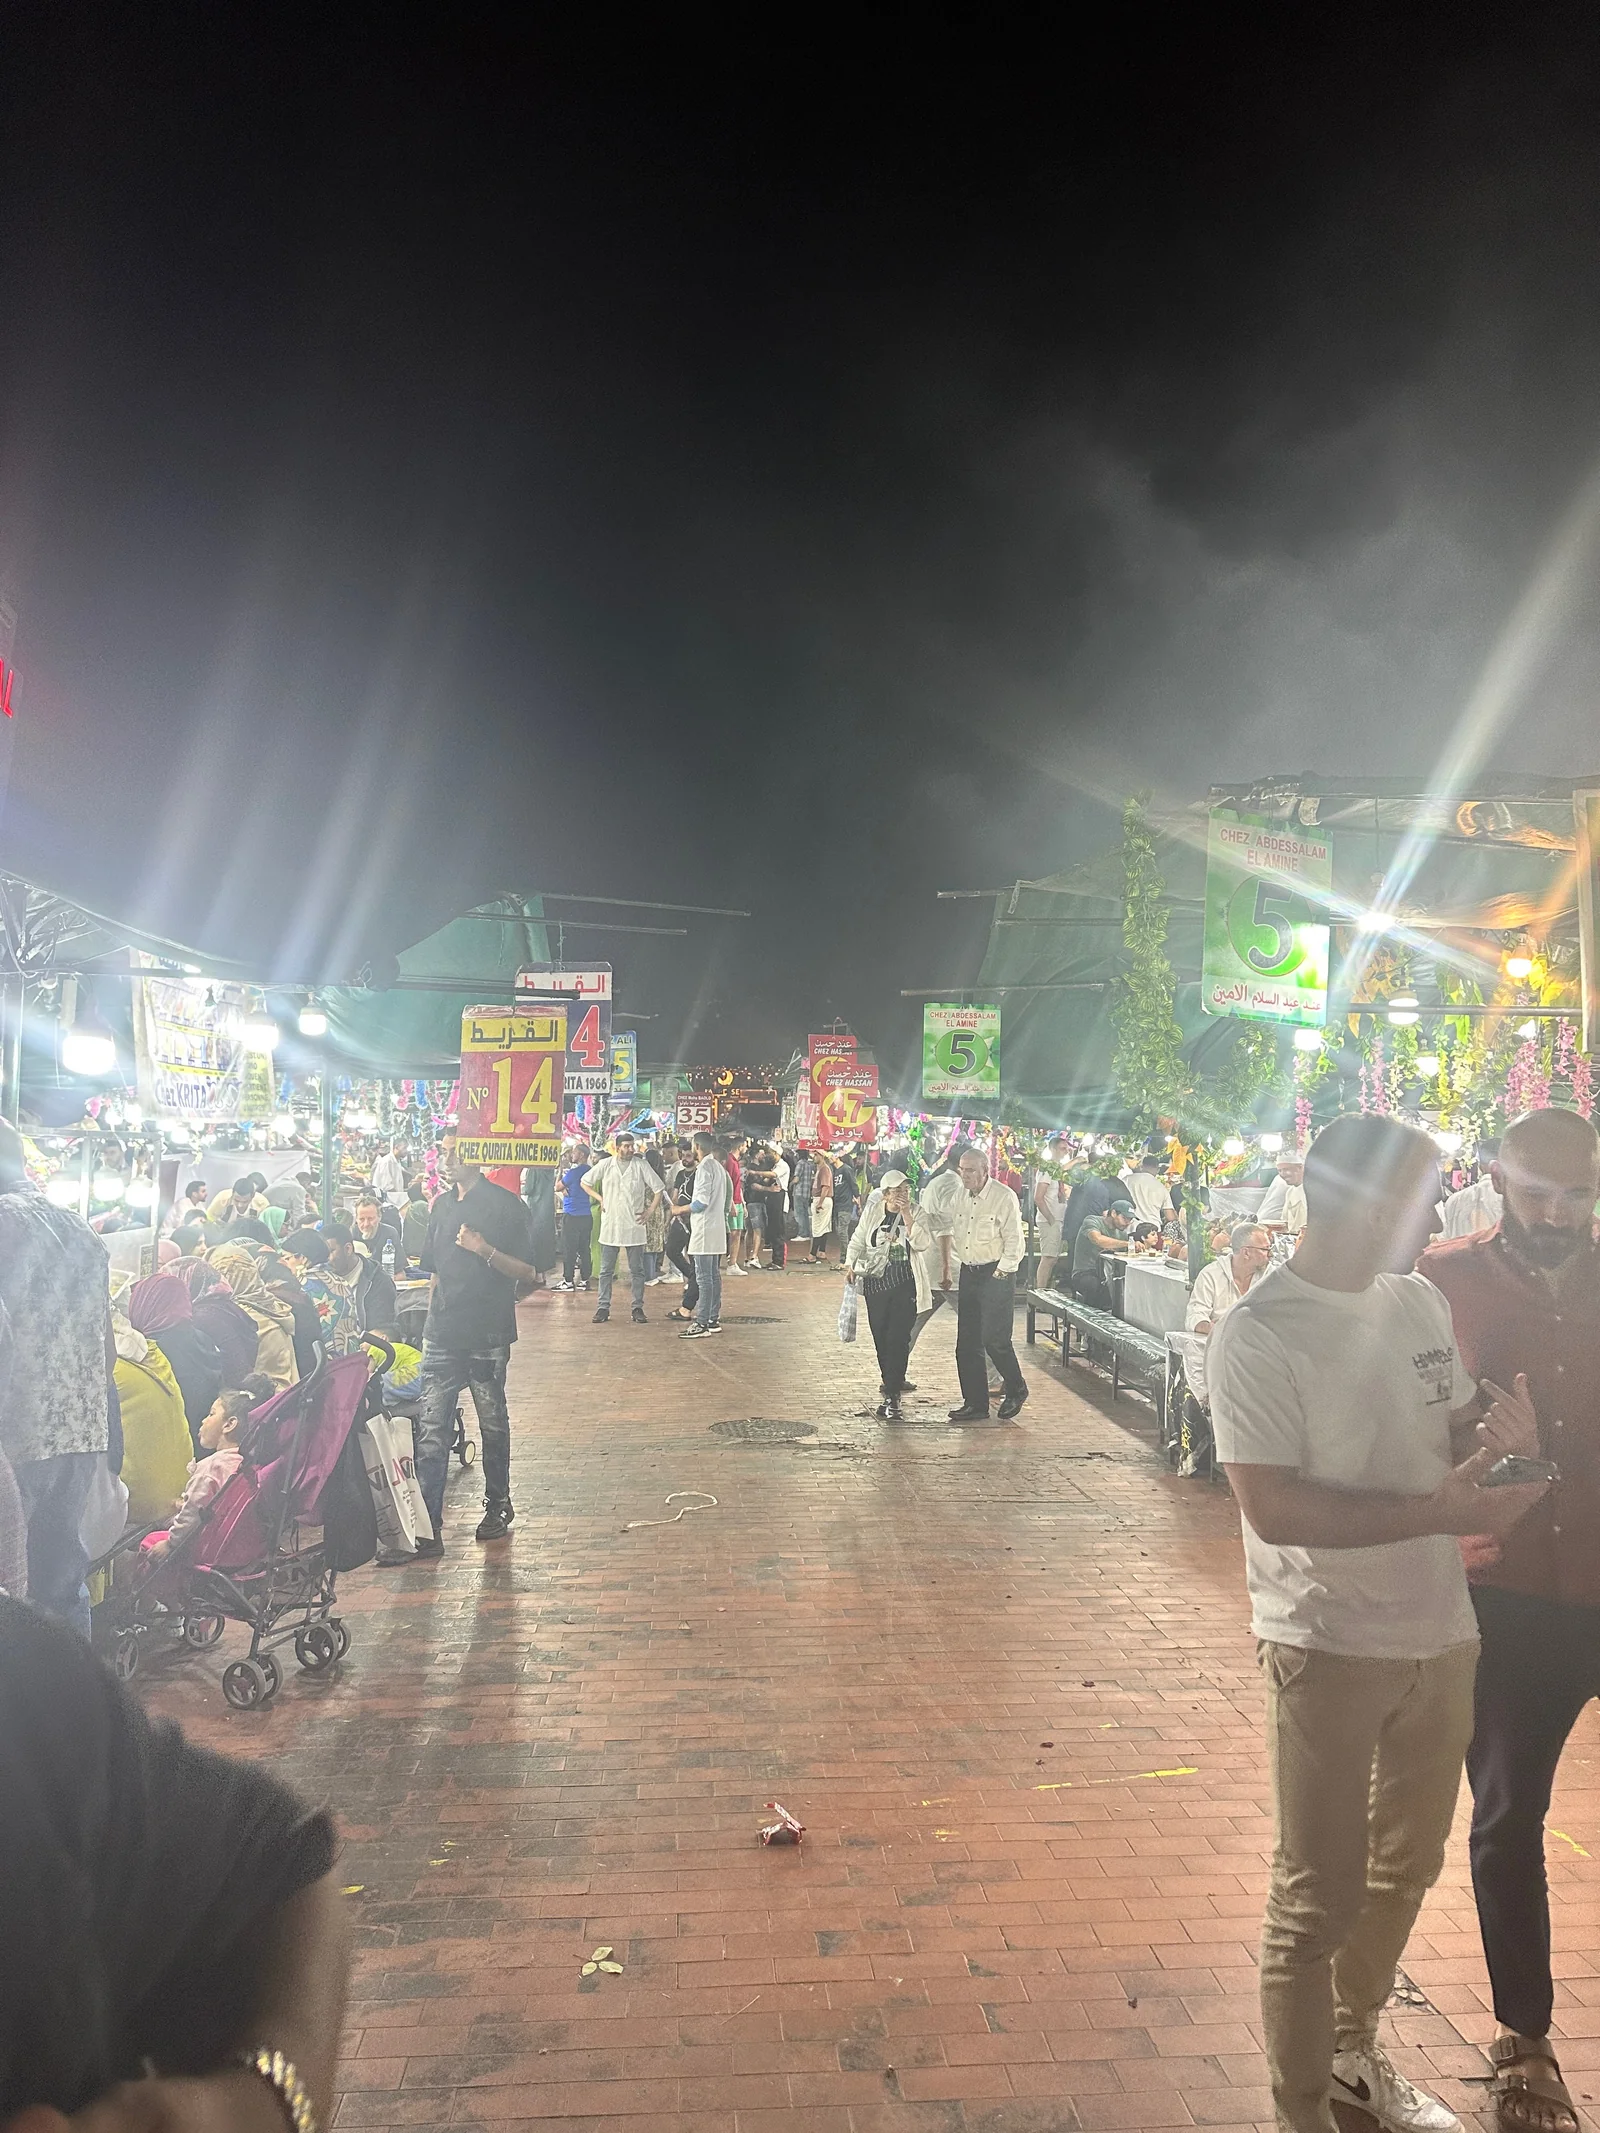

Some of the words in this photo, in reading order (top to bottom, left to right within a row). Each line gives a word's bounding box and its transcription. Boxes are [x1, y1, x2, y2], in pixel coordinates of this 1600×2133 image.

[1220, 829, 1250, 845] CHEZ
[1256, 834, 1326, 860] ABDESSALAM
[1247, 850, 1260, 865] EL
[1264, 853, 1298, 872] AMINE
[1248, 880, 1293, 970] 5
[1251, 991, 1280, 1009] السلام
[1282, 997, 1299, 1010] عبد
[1303, 999, 1321, 1011] عند
[956, 1020, 977, 1028] AMINE
[617, 1035, 632, 1044] ALI
[948, 1033, 976, 1075] 5
[844, 1079, 873, 1087] HASSAN
[852, 1069, 872, 1079] عند
[585, 1077, 607, 1090] 1966
[176, 1083, 206, 1109] KRITA
[490, 1056, 558, 1134] 14
[679, 1108, 708, 1124] 35
[827, 1093, 866, 1123] 47
[459, 1142, 481, 1160] CHEZ
[482, 1142, 512, 1162] QURITA
[515, 1143, 538, 1161] SINCE
[540, 1146, 558, 1162] 1966
